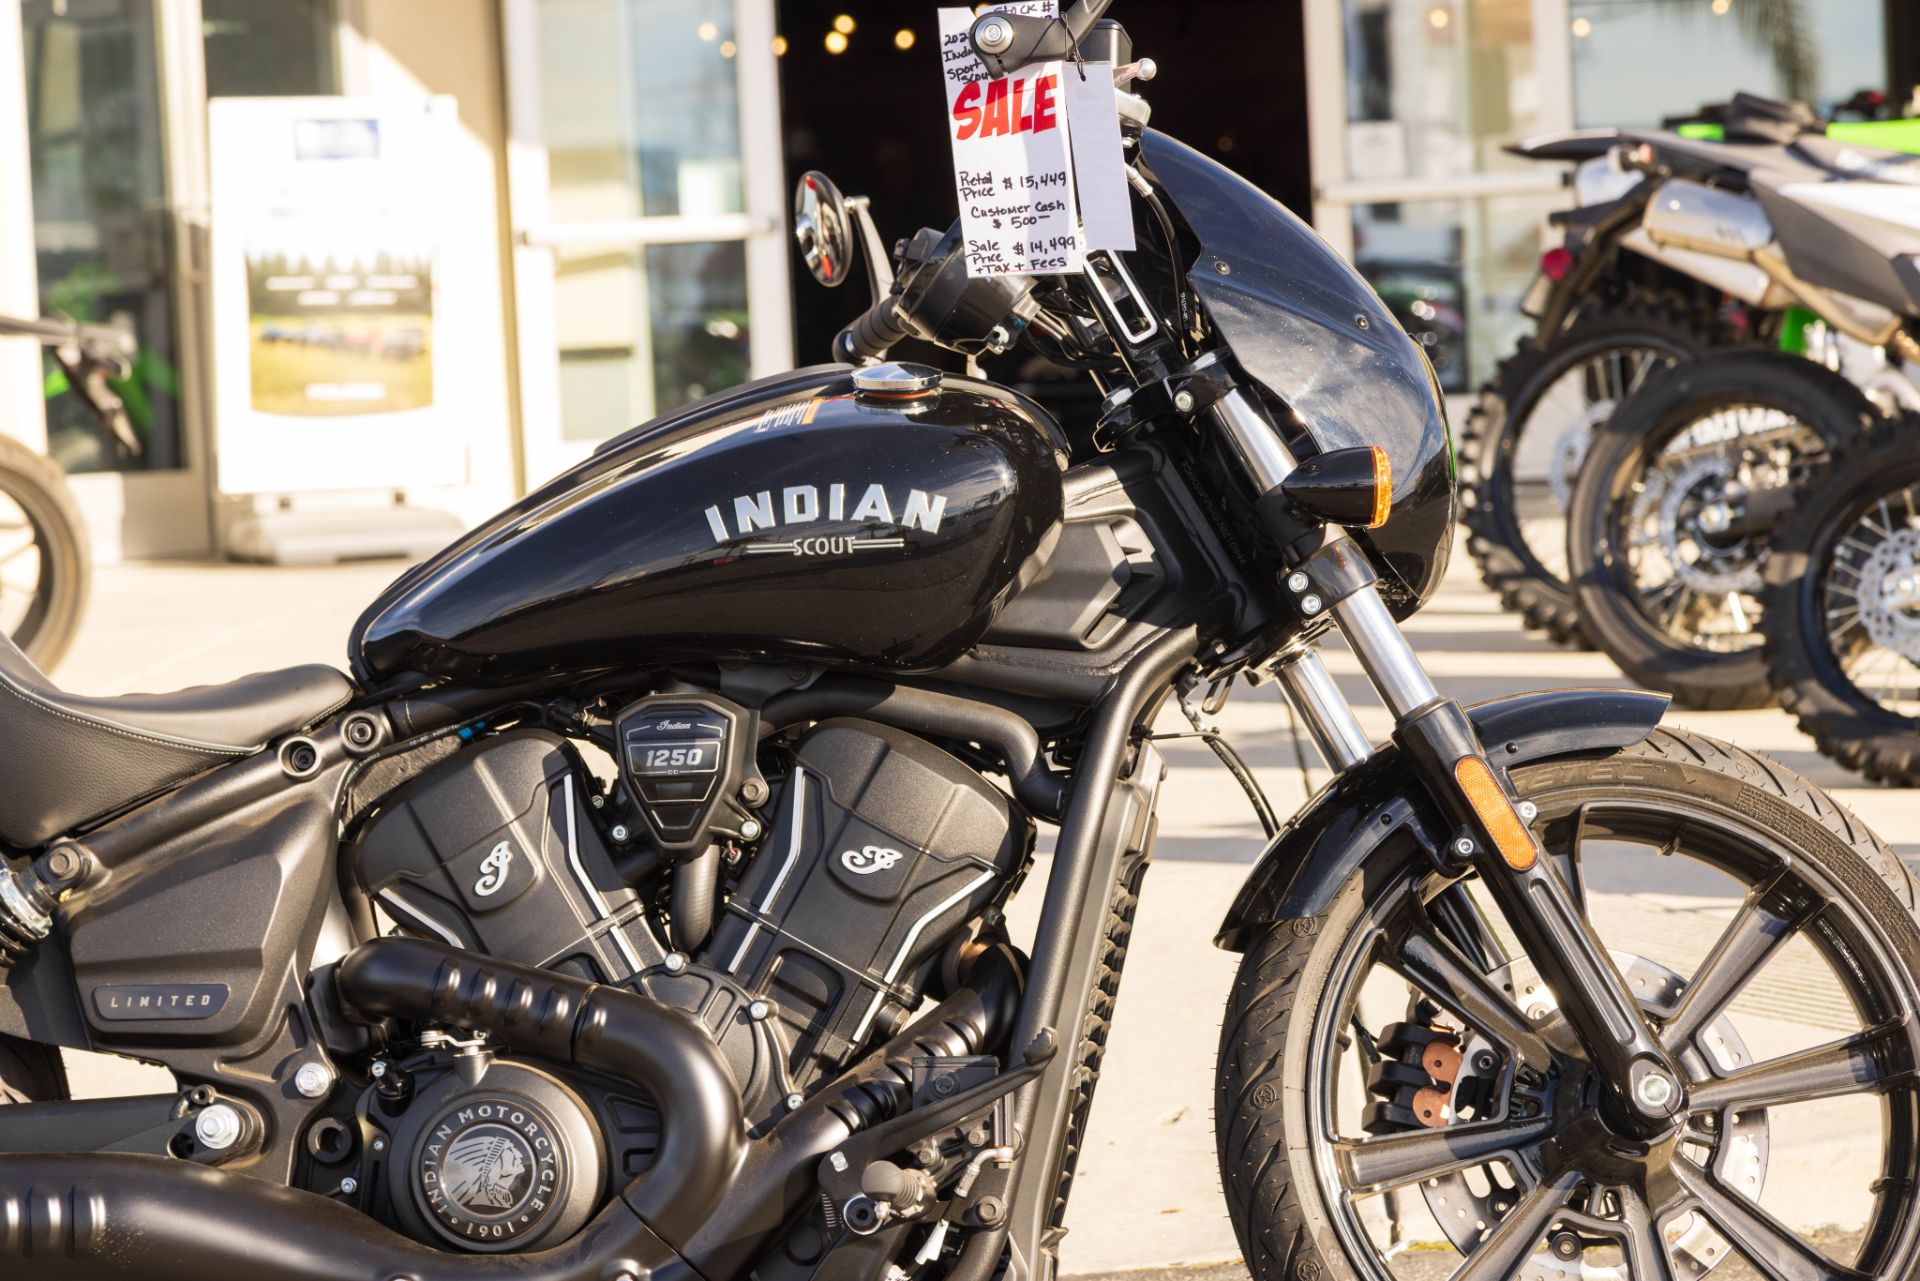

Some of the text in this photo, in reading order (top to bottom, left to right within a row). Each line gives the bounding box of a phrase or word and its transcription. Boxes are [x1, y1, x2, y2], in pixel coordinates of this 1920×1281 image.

[944, 32, 969, 47] 202
[952, 73, 1058, 141] SALE
[959, 170, 993, 187] Retail
[1020, 171, 1067, 190] 15,449
[959, 186, 996, 202] Price
[971, 200, 1066, 219] Customer Cash
[968, 239, 1000, 253] Sale
[1030, 236, 1076, 255] 14,499
[966, 253, 1004, 265] Price
[1030, 257, 1068, 271] Fees
[704, 483, 948, 544] INDIAN
[792, 536, 855, 556] SCOUT
[656, 719, 691, 731] Indian
[646, 748, 703, 767] 1250
[110, 995, 210, 1008] LIMITED
[424, 1105, 555, 1214] INDIAN MOTORCYCLE
[466, 1221, 515, 1237] 1901
